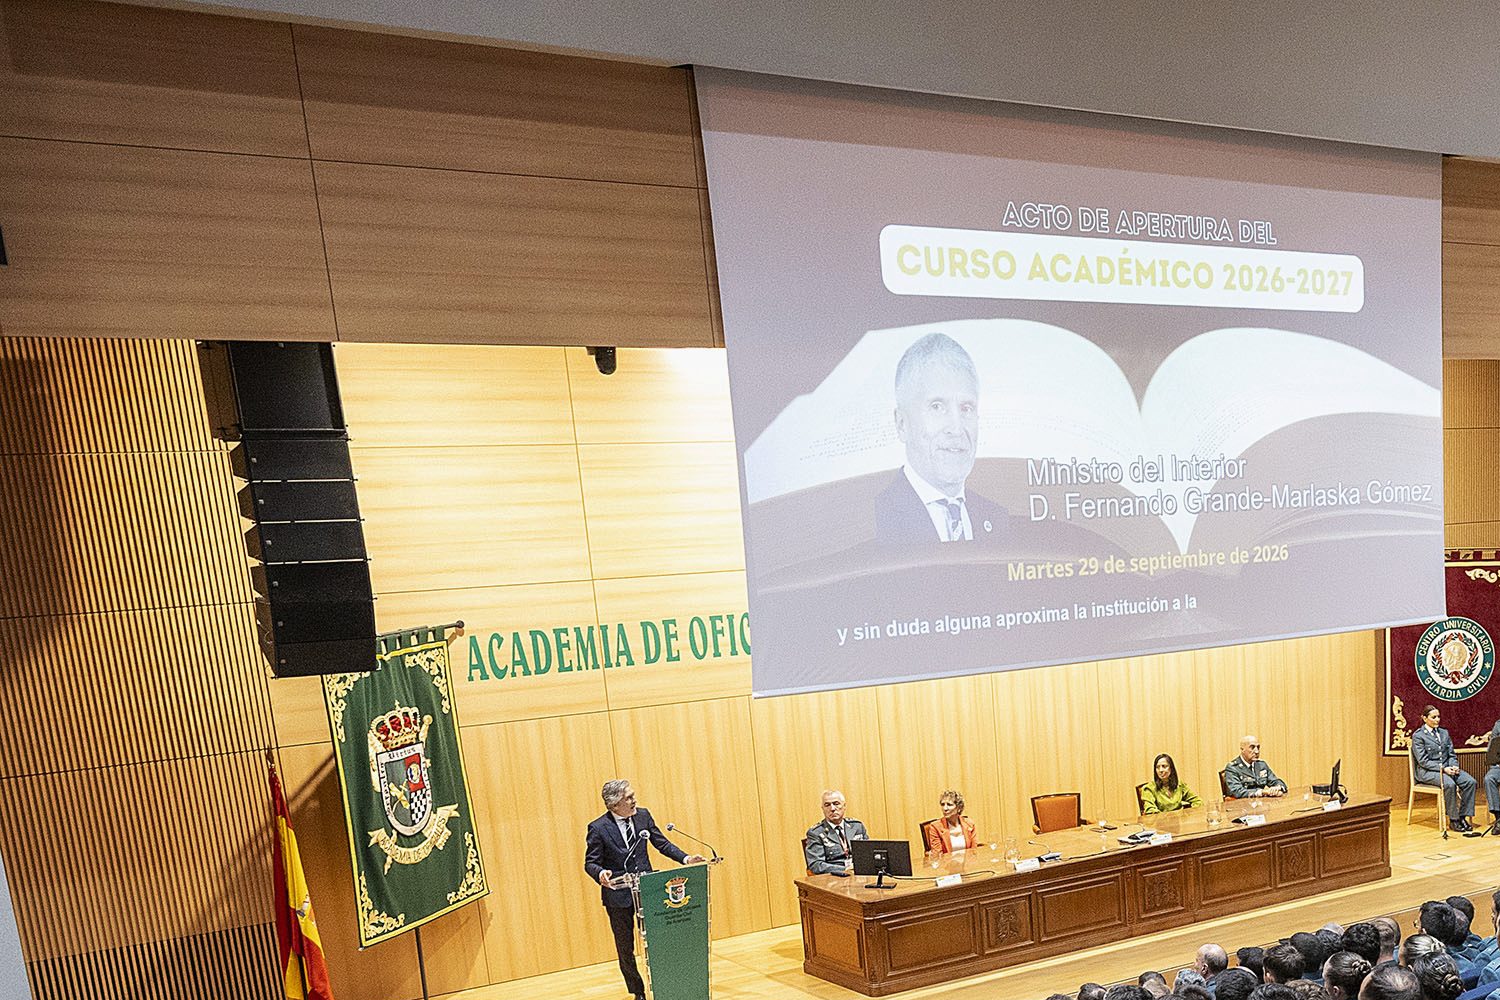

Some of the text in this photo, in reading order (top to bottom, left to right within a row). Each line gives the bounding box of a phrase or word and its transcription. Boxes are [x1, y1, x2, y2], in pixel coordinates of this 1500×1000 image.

[1003, 201, 1277, 245] ACTO DE APERTURA DEL
[896, 244, 1354, 296] CURSO ACADÉMICO 2026-2027
[1027, 453, 1246, 486] Ministro del Interior
[1029, 479, 1433, 522] D. Fernando Grande-Marlaska Gómez
[1007, 544, 1289, 582] Martes 29 de septiembre de 2026
[836, 594, 1197, 646] y sin duda alguna aproxima la institución a la
[1418, 619, 1492, 657] CENTRO UNIVERSITARIO
[467, 623, 635, 682] ACADEMIA
[640, 619, 681, 665] DE
[1424, 675, 1488, 699] GUARDIA CIVIL
